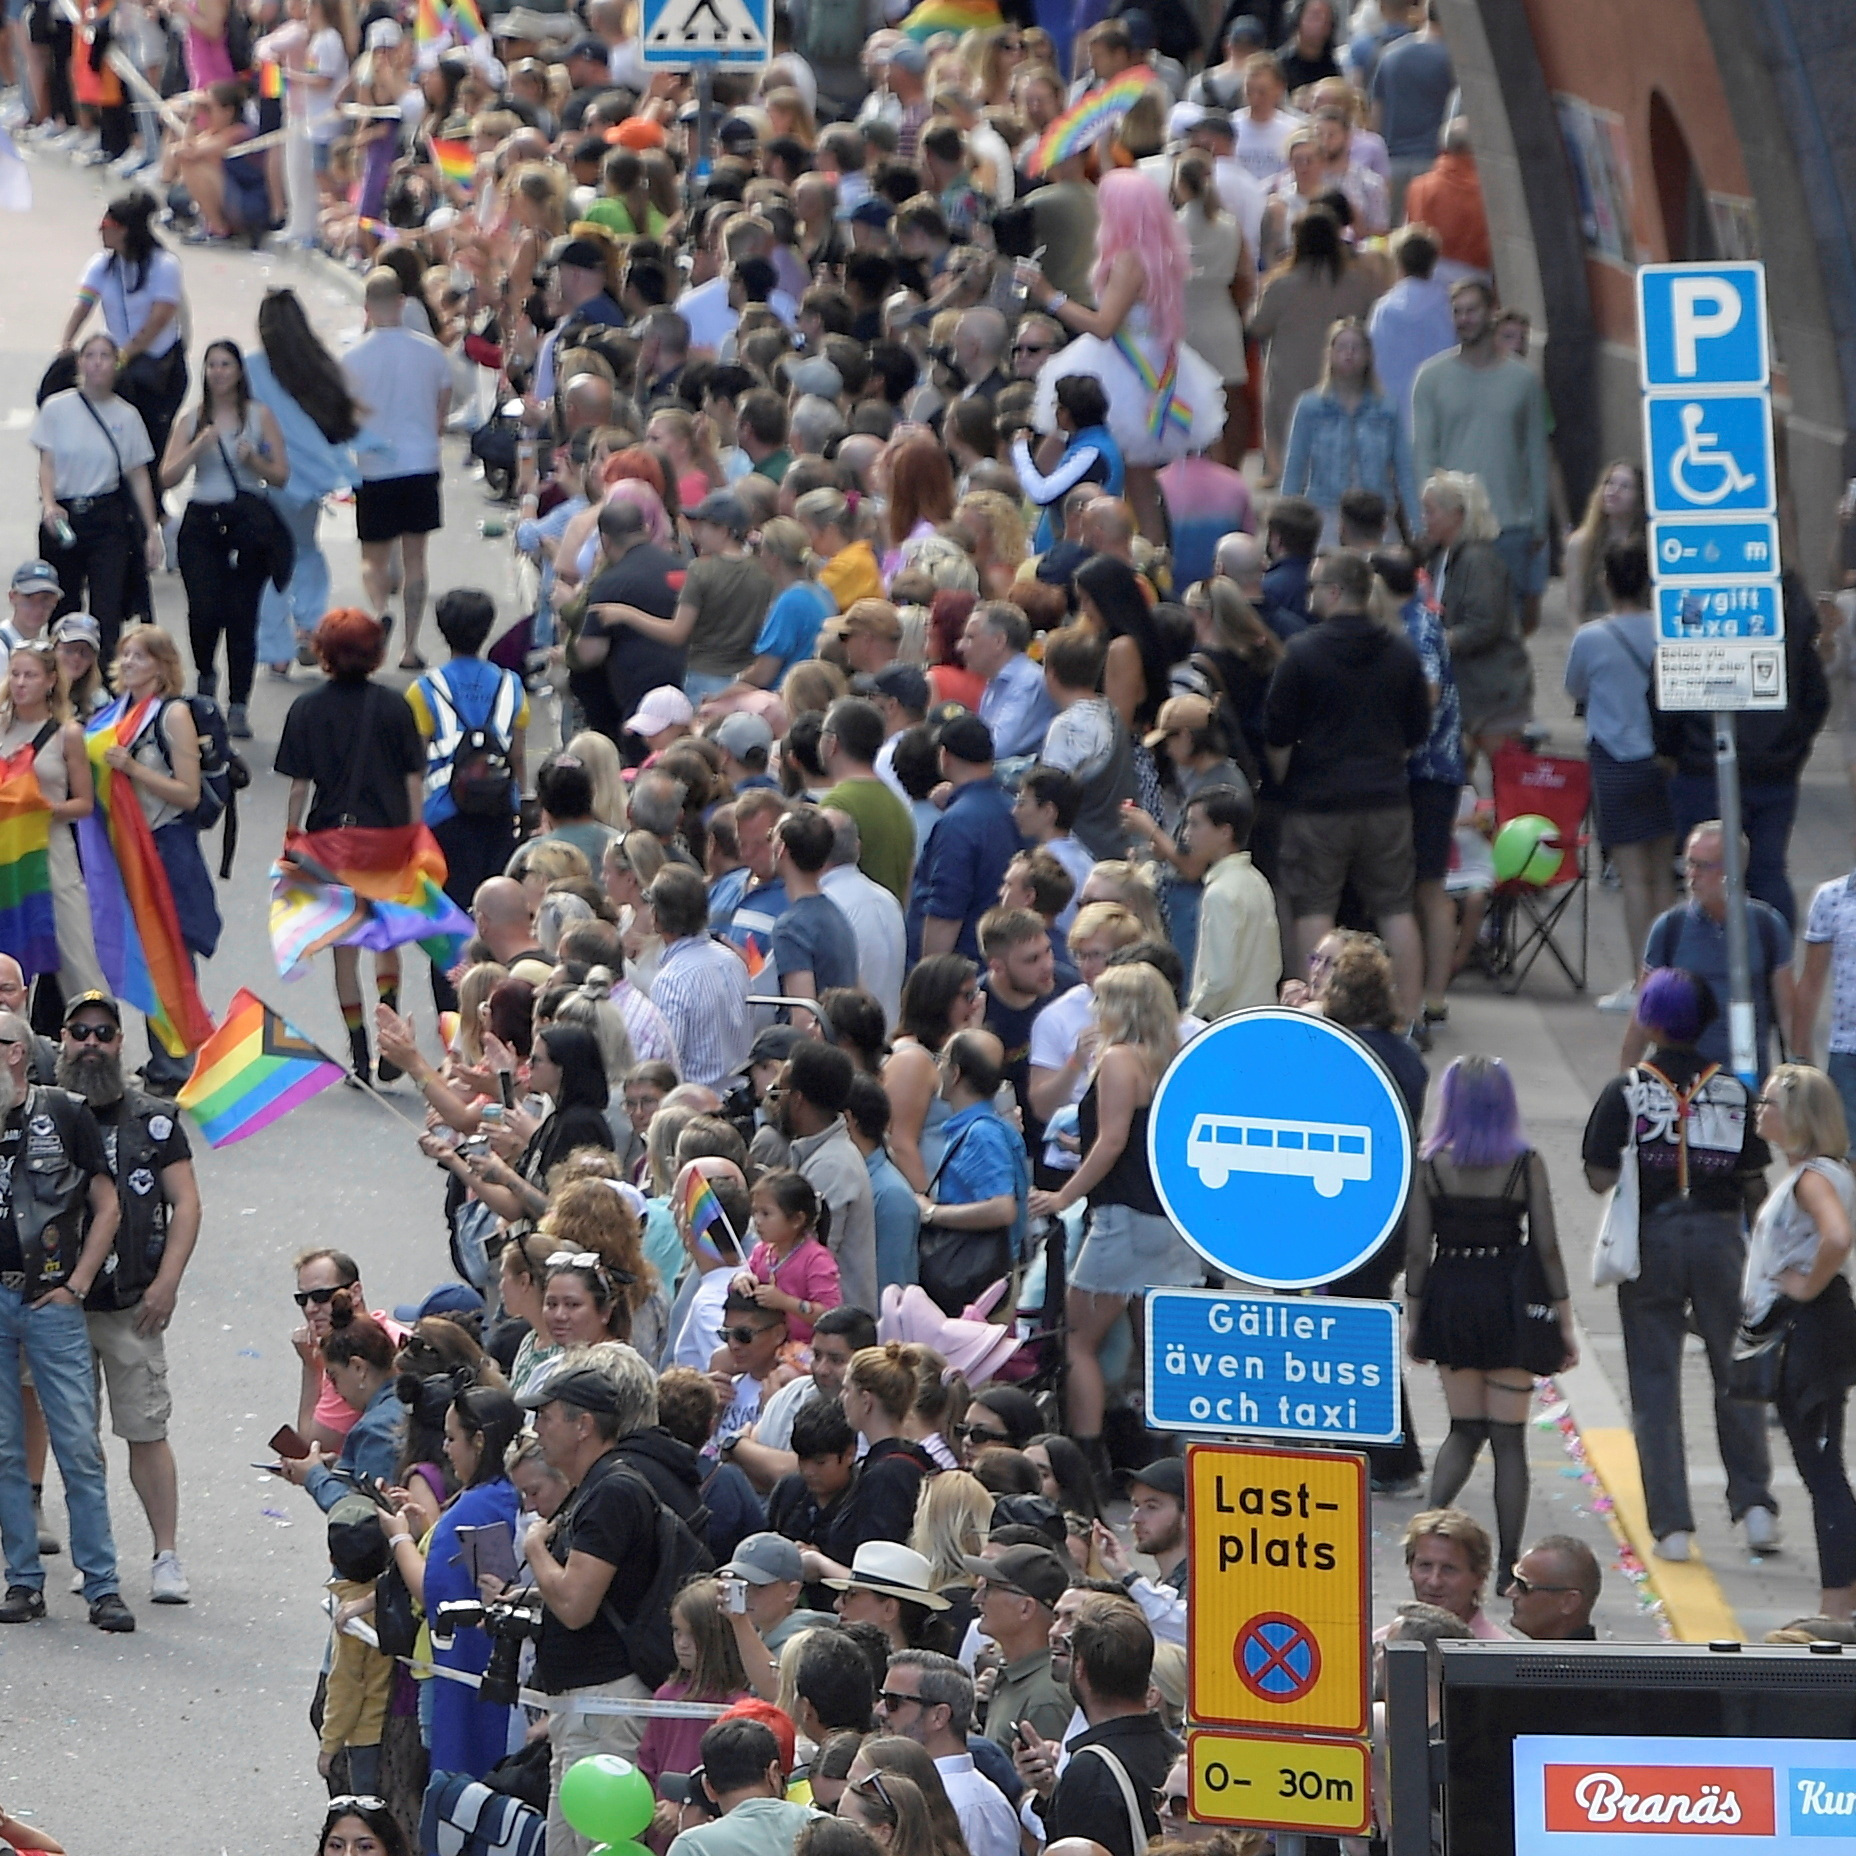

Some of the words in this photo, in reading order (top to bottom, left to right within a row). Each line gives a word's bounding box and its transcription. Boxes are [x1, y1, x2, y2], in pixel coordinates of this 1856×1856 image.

[1671, 276, 1742, 378] P
[1744, 541, 1768, 562] m
[1208, 1303, 1337, 1341] Gäller
[1165, 1343, 1264, 1380] även
[1285, 1351, 1381, 1387] buss
[1189, 1392, 1260, 1423] och
[1278, 1395, 1357, 1430] taxi
[1215, 1475, 1339, 1519] Last-
[1218, 1527, 1336, 1572] plats
[1278, 1768, 1354, 1802] 30m
[1575, 1771, 1742, 1825] Branäs
